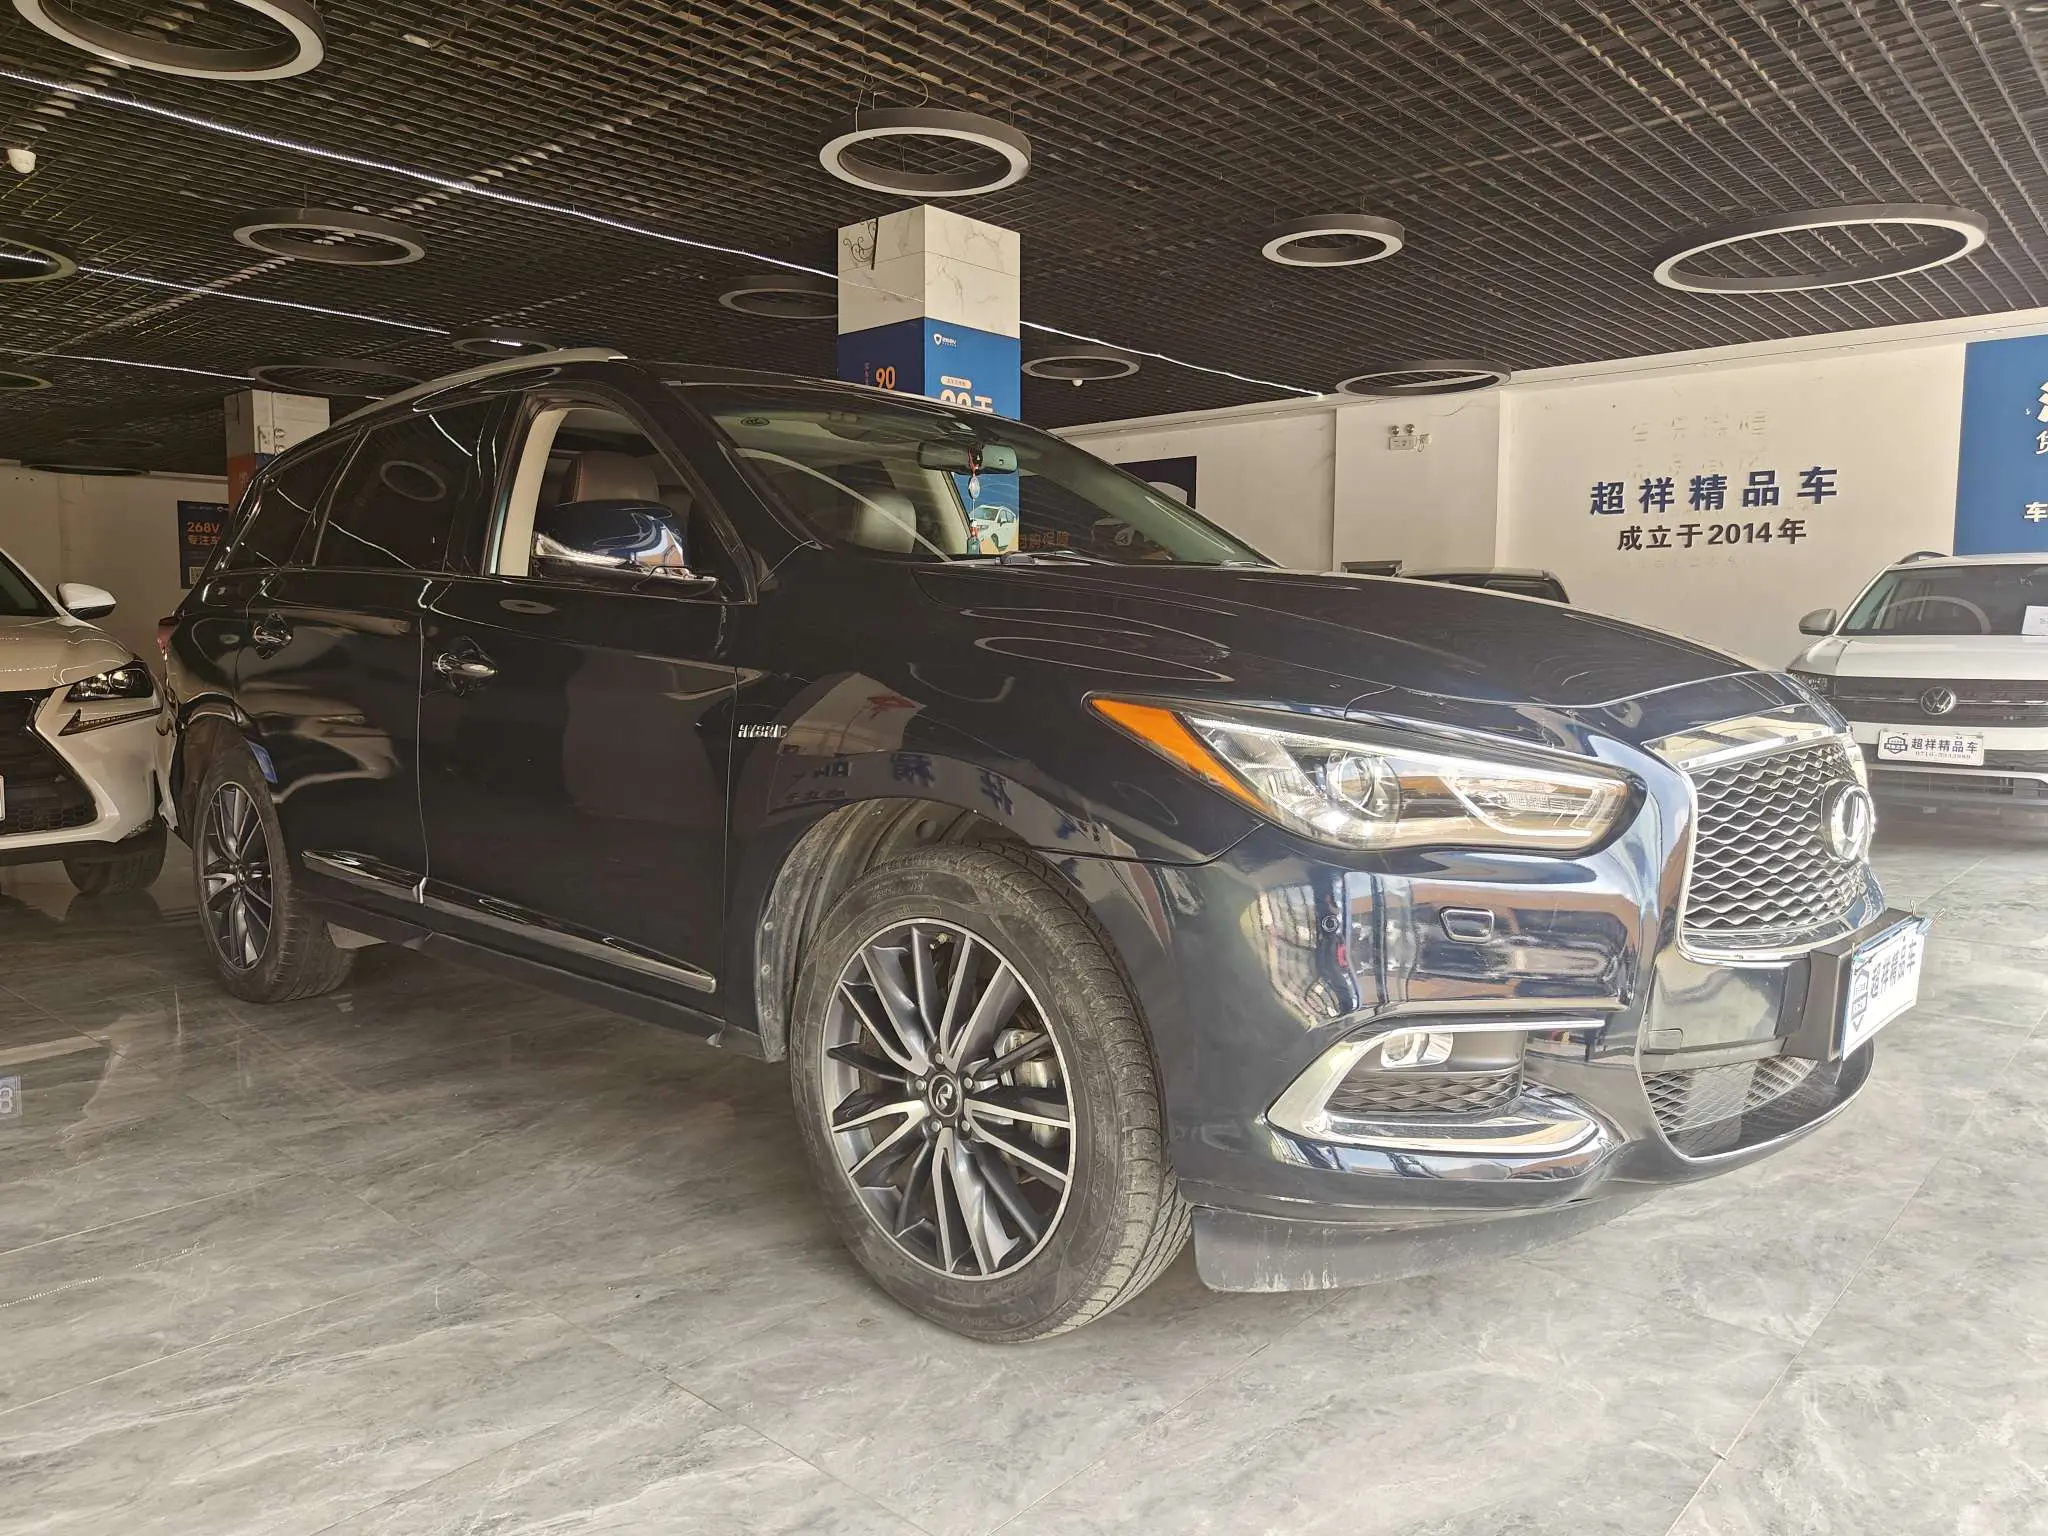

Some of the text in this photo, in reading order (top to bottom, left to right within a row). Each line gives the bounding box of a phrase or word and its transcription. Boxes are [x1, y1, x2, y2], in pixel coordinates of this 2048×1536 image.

[1590, 466, 1838, 515] 超祥精品车
[1617, 518, 1807, 551] 成立于2014年
[1911, 738, 1978, 754] 超祥精品车
